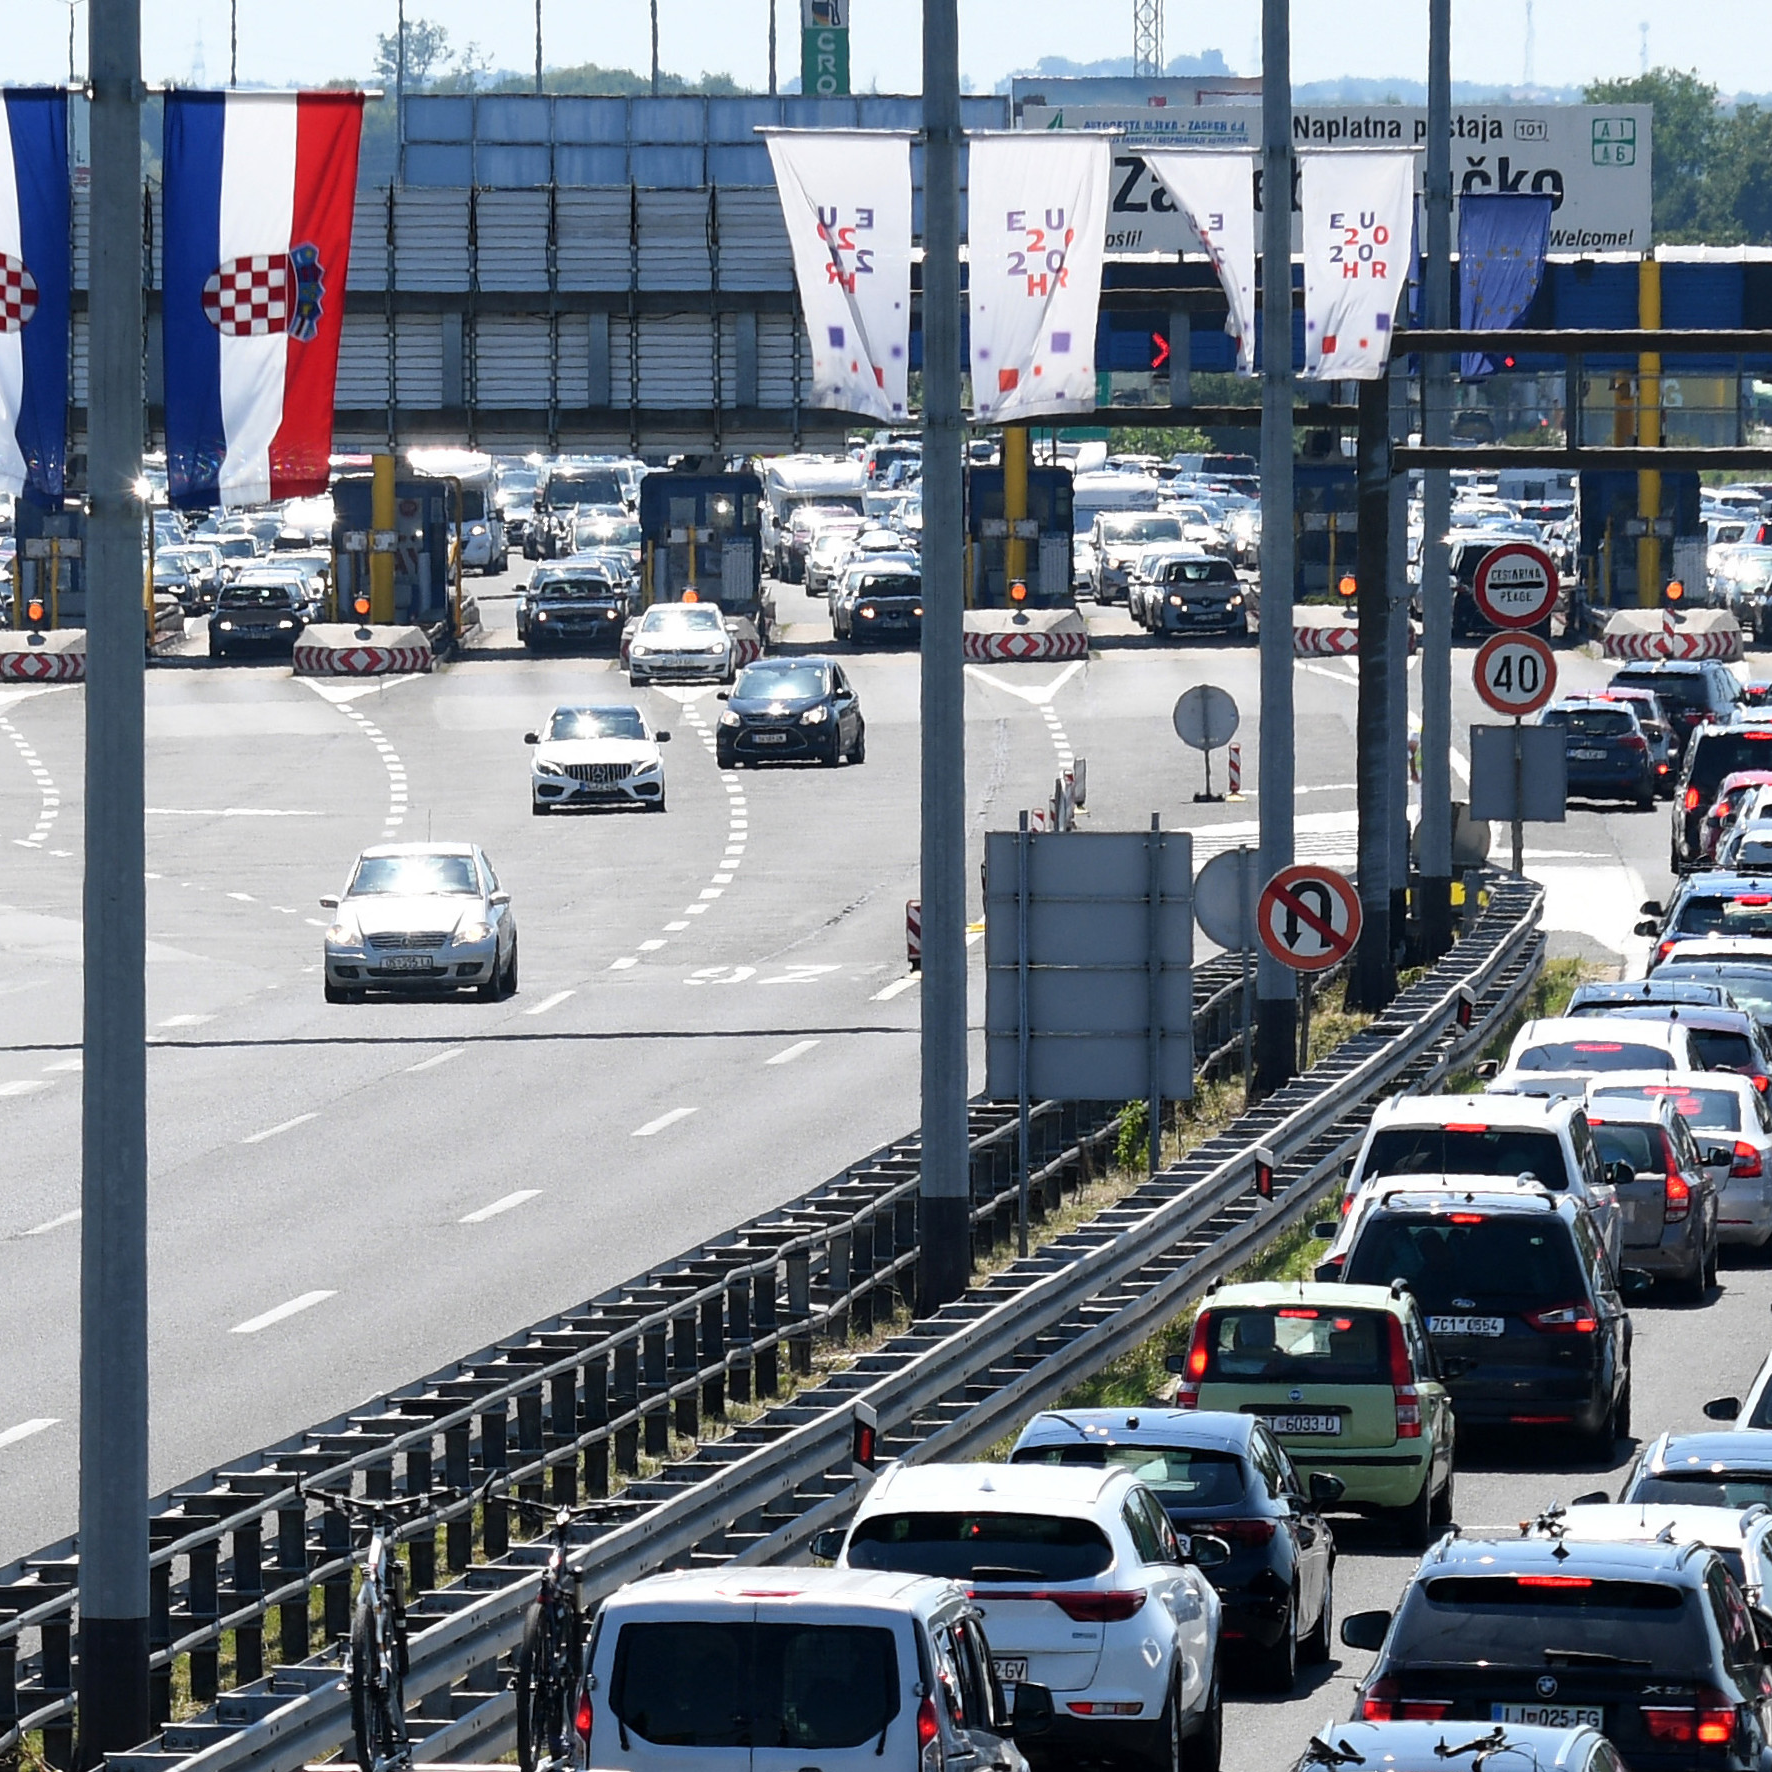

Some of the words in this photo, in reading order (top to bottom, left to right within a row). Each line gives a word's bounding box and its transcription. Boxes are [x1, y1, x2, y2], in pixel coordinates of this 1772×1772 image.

[1293, 115, 1401, 143] Naplatna
[1414, 117, 1503, 144] pstaja
[1519, 124, 1543, 137] 101
[1330, 212, 1376, 230] EU
[1344, 226, 1389, 246] 20
[1549, 229, 1634, 248] Welcome!
[1329, 244, 1373, 263] 20
[1343, 261, 1387, 279] HR
[1491, 569, 1541, 580] CESTARINA
[1493, 655, 1539, 693] 40
[1286, 1418, 1335, 1431] 6033-D
